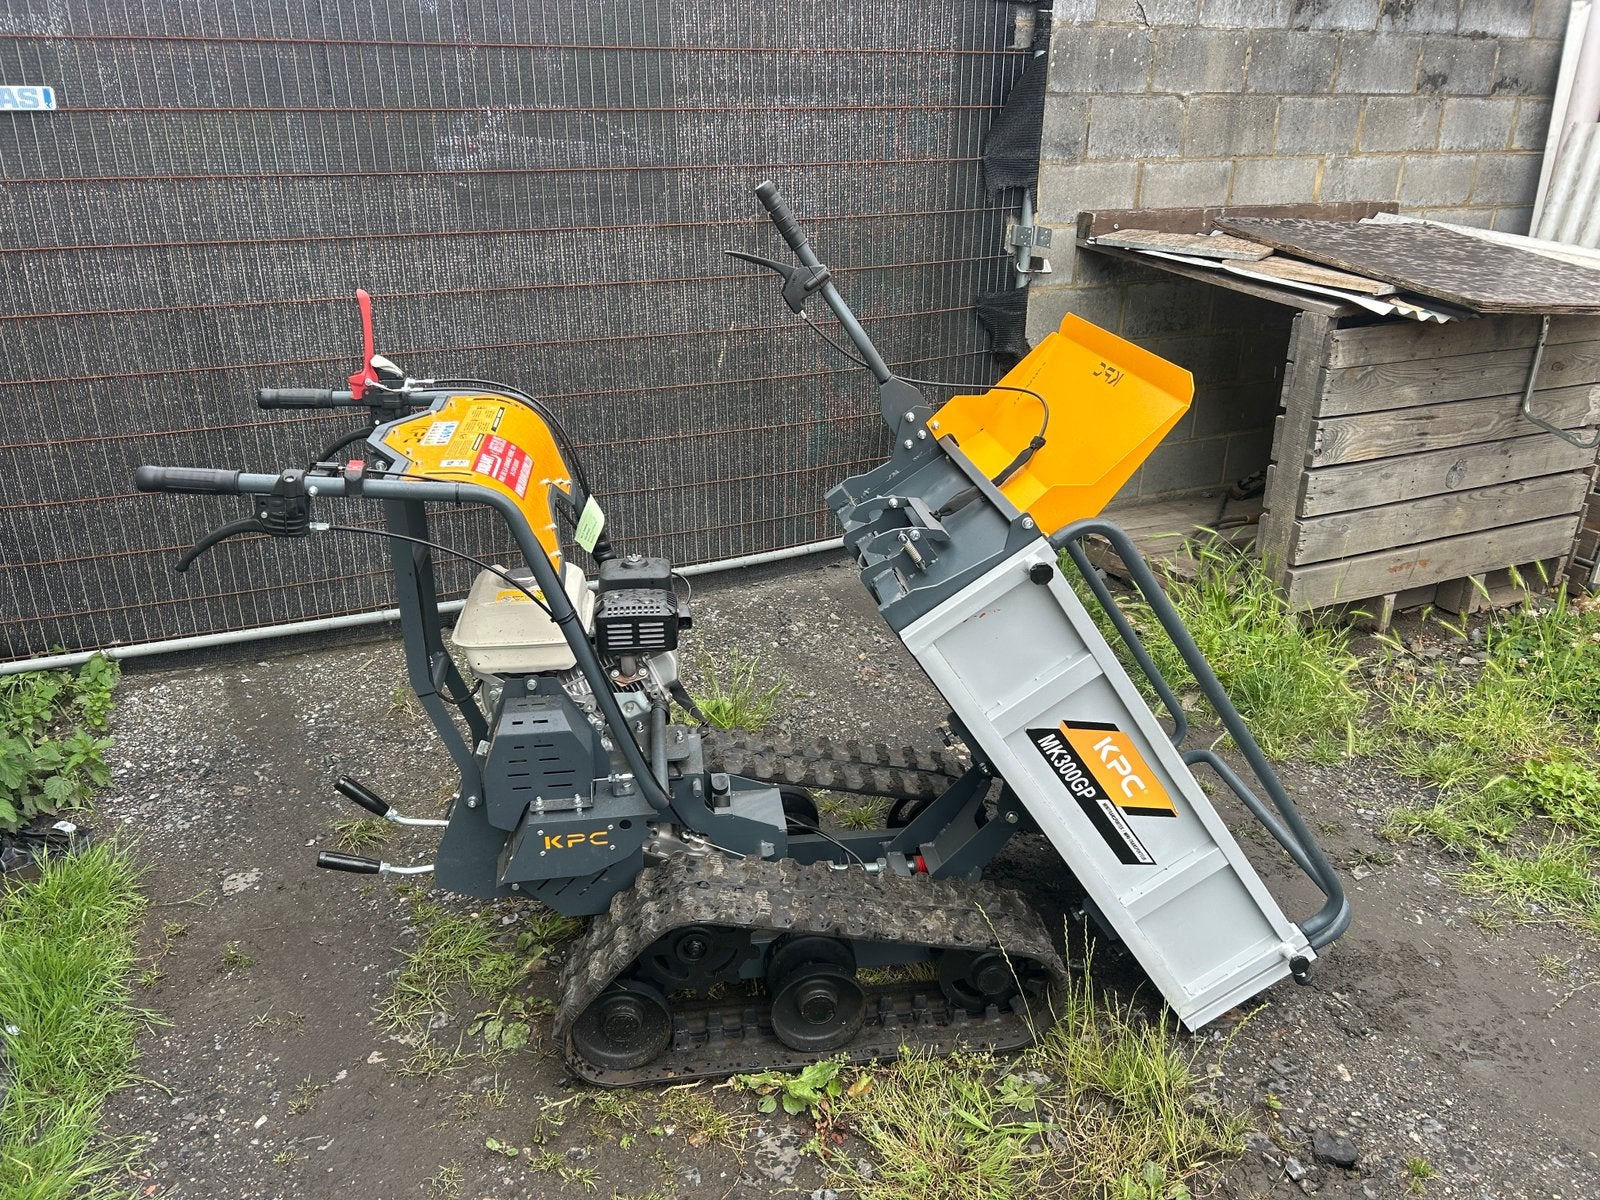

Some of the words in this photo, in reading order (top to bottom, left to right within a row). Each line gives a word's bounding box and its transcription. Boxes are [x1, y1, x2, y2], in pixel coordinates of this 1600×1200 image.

[1038, 734, 1096, 799] MK300GP
[1094, 737, 1146, 798] KPC
[544, 831, 608, 850] KPC
